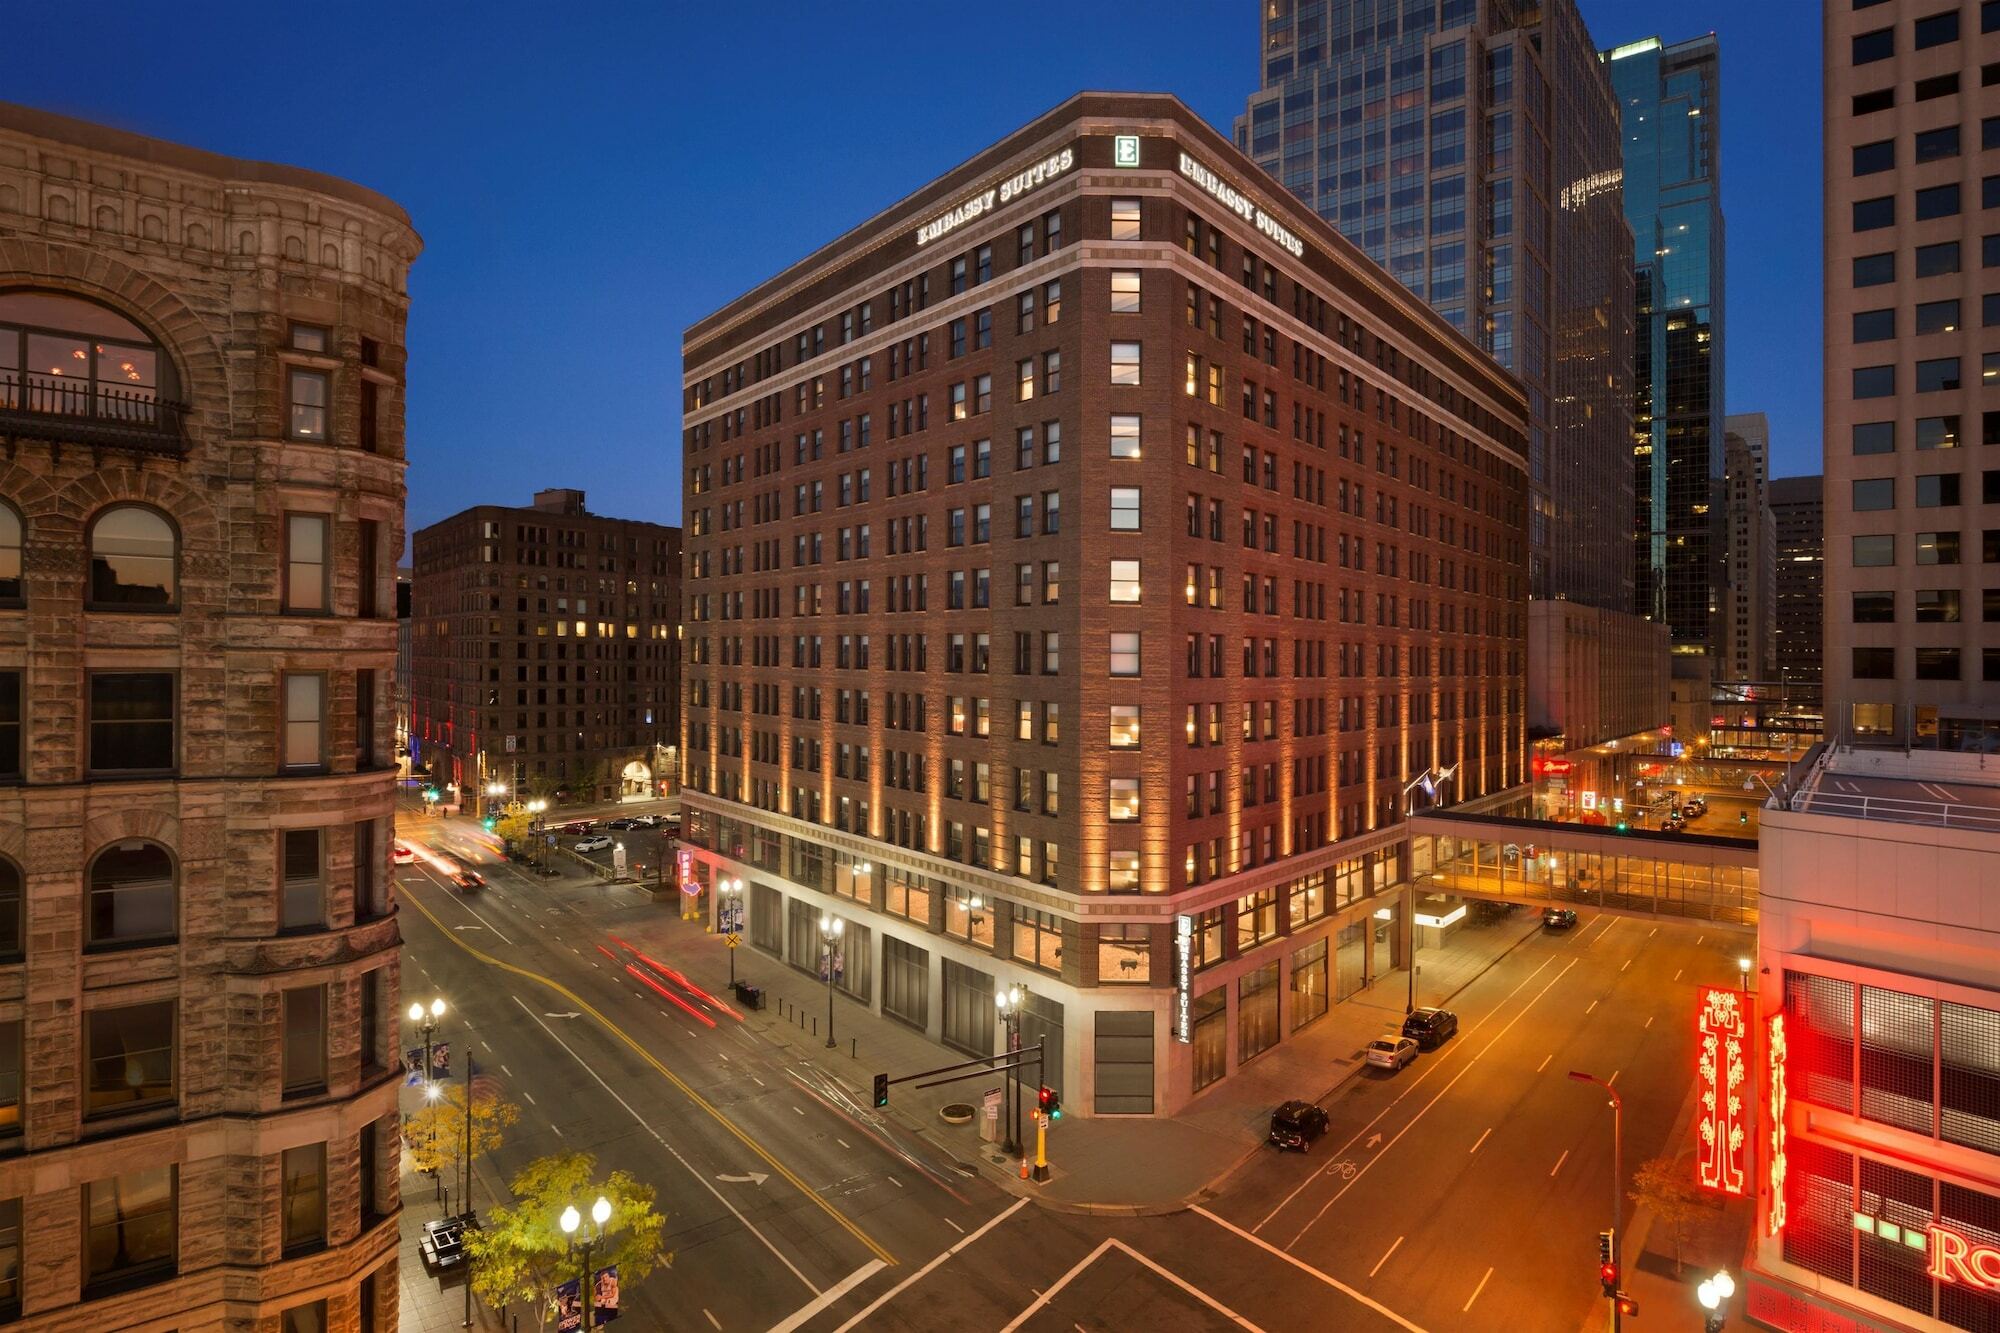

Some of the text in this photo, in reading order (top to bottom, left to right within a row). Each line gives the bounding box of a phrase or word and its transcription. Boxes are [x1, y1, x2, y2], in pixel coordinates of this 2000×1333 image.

[1118, 139, 1136, 163] E
[916, 148, 1073, 246] EMBASSY SUITES
[1179, 152, 1304, 258] EMBASSY SUITES
[1180, 992, 1189, 1037] SUITES
